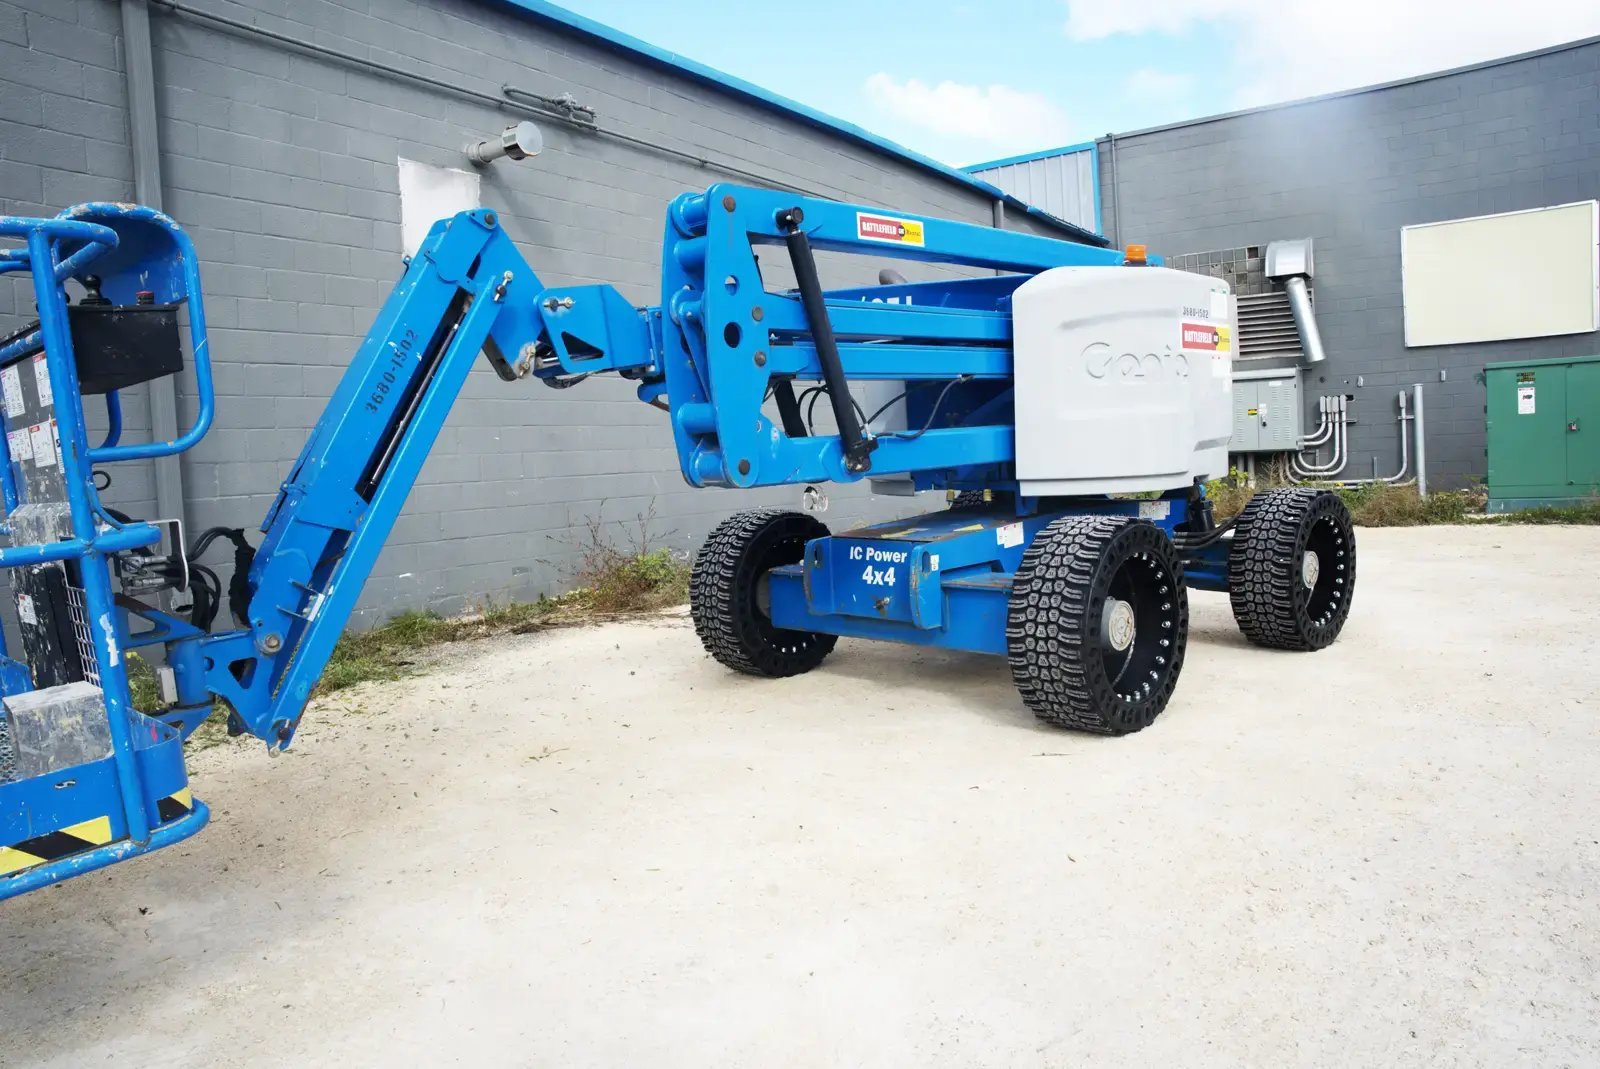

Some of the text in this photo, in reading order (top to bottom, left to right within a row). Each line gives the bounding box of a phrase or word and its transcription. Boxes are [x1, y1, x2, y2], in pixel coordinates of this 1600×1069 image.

[862, 221, 897, 235] BATTLEFIELD
[1183, 306, 1209, 318] 3680-1502
[365, 329, 418, 413] 3680-1502
[849, 546, 908, 563] IC Power
[862, 565, 896, 586] 4x4
